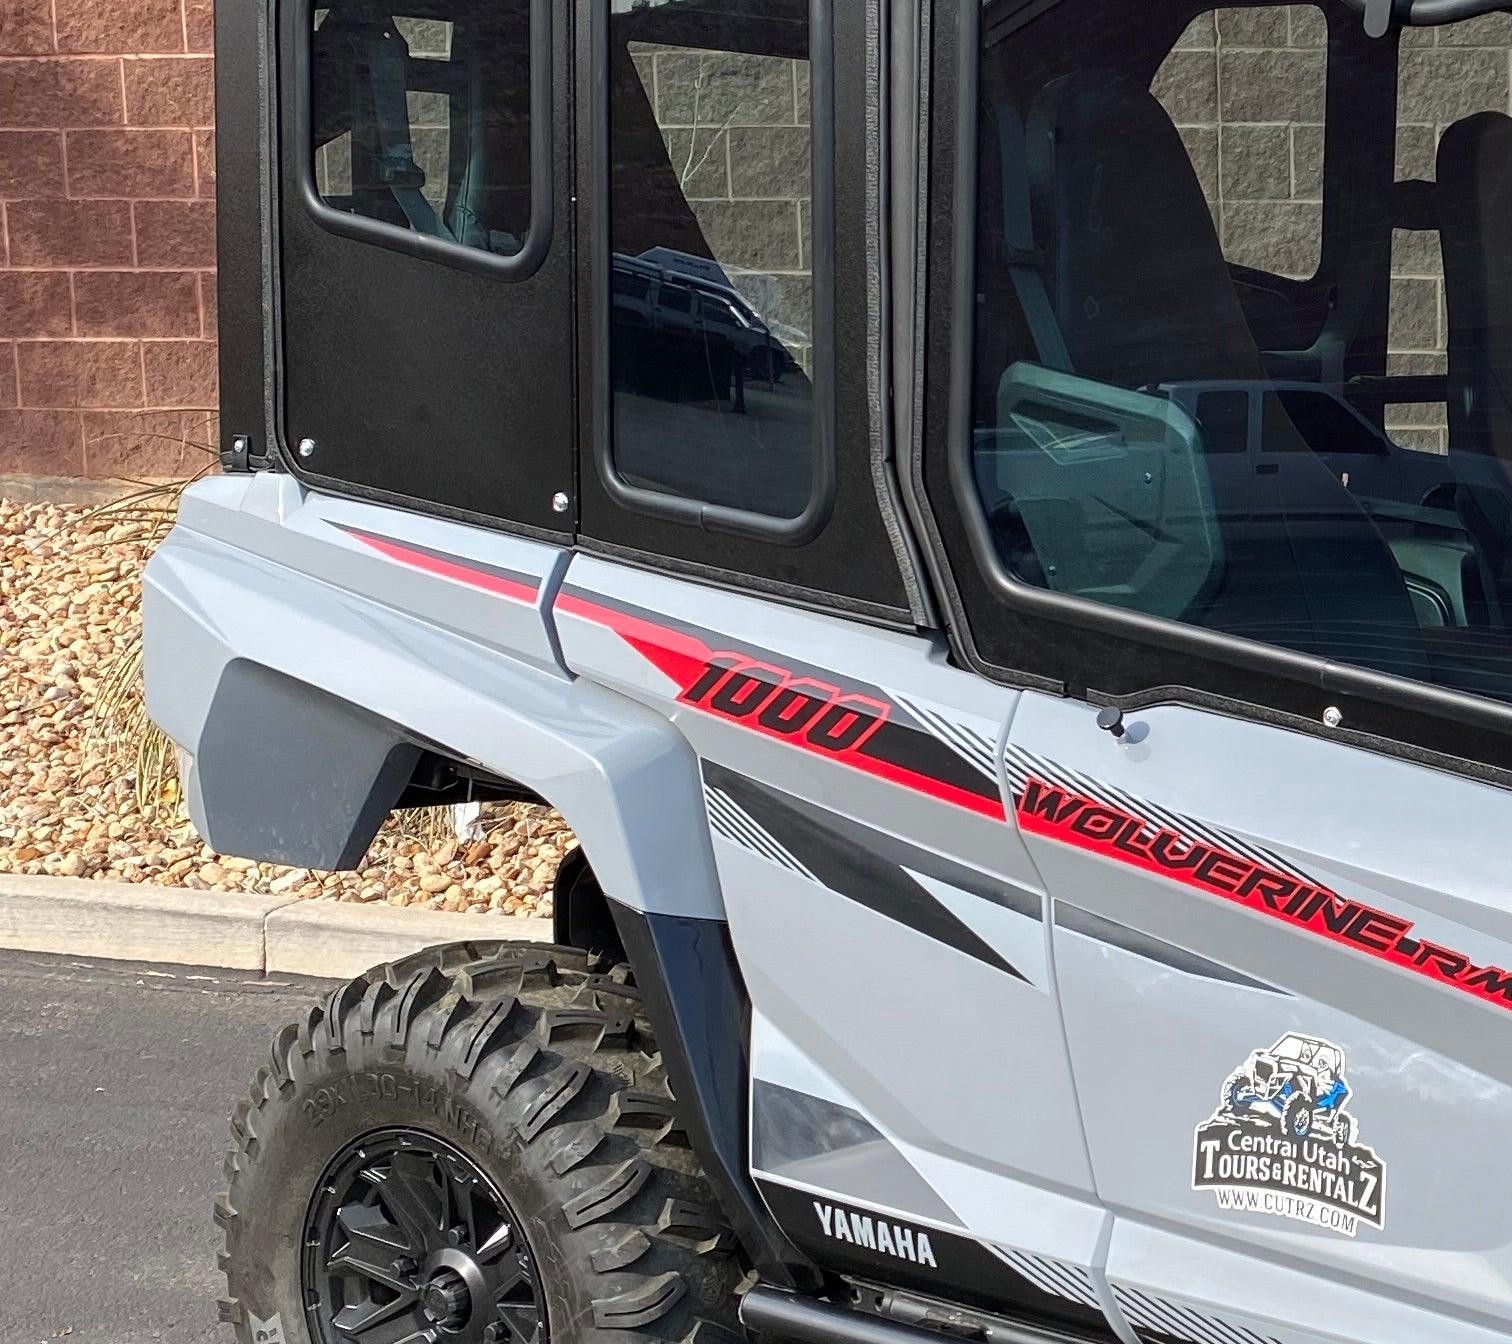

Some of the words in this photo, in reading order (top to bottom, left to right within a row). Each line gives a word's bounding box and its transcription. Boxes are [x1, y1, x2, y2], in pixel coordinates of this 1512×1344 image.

[688, 656, 887, 752] 1000
[1023, 779, 1411, 951] WOLVERINE
[1227, 1130, 1298, 1158] Central
[1303, 1140, 1350, 1176] Utah
[812, 1201, 938, 1268] YAMAHA
